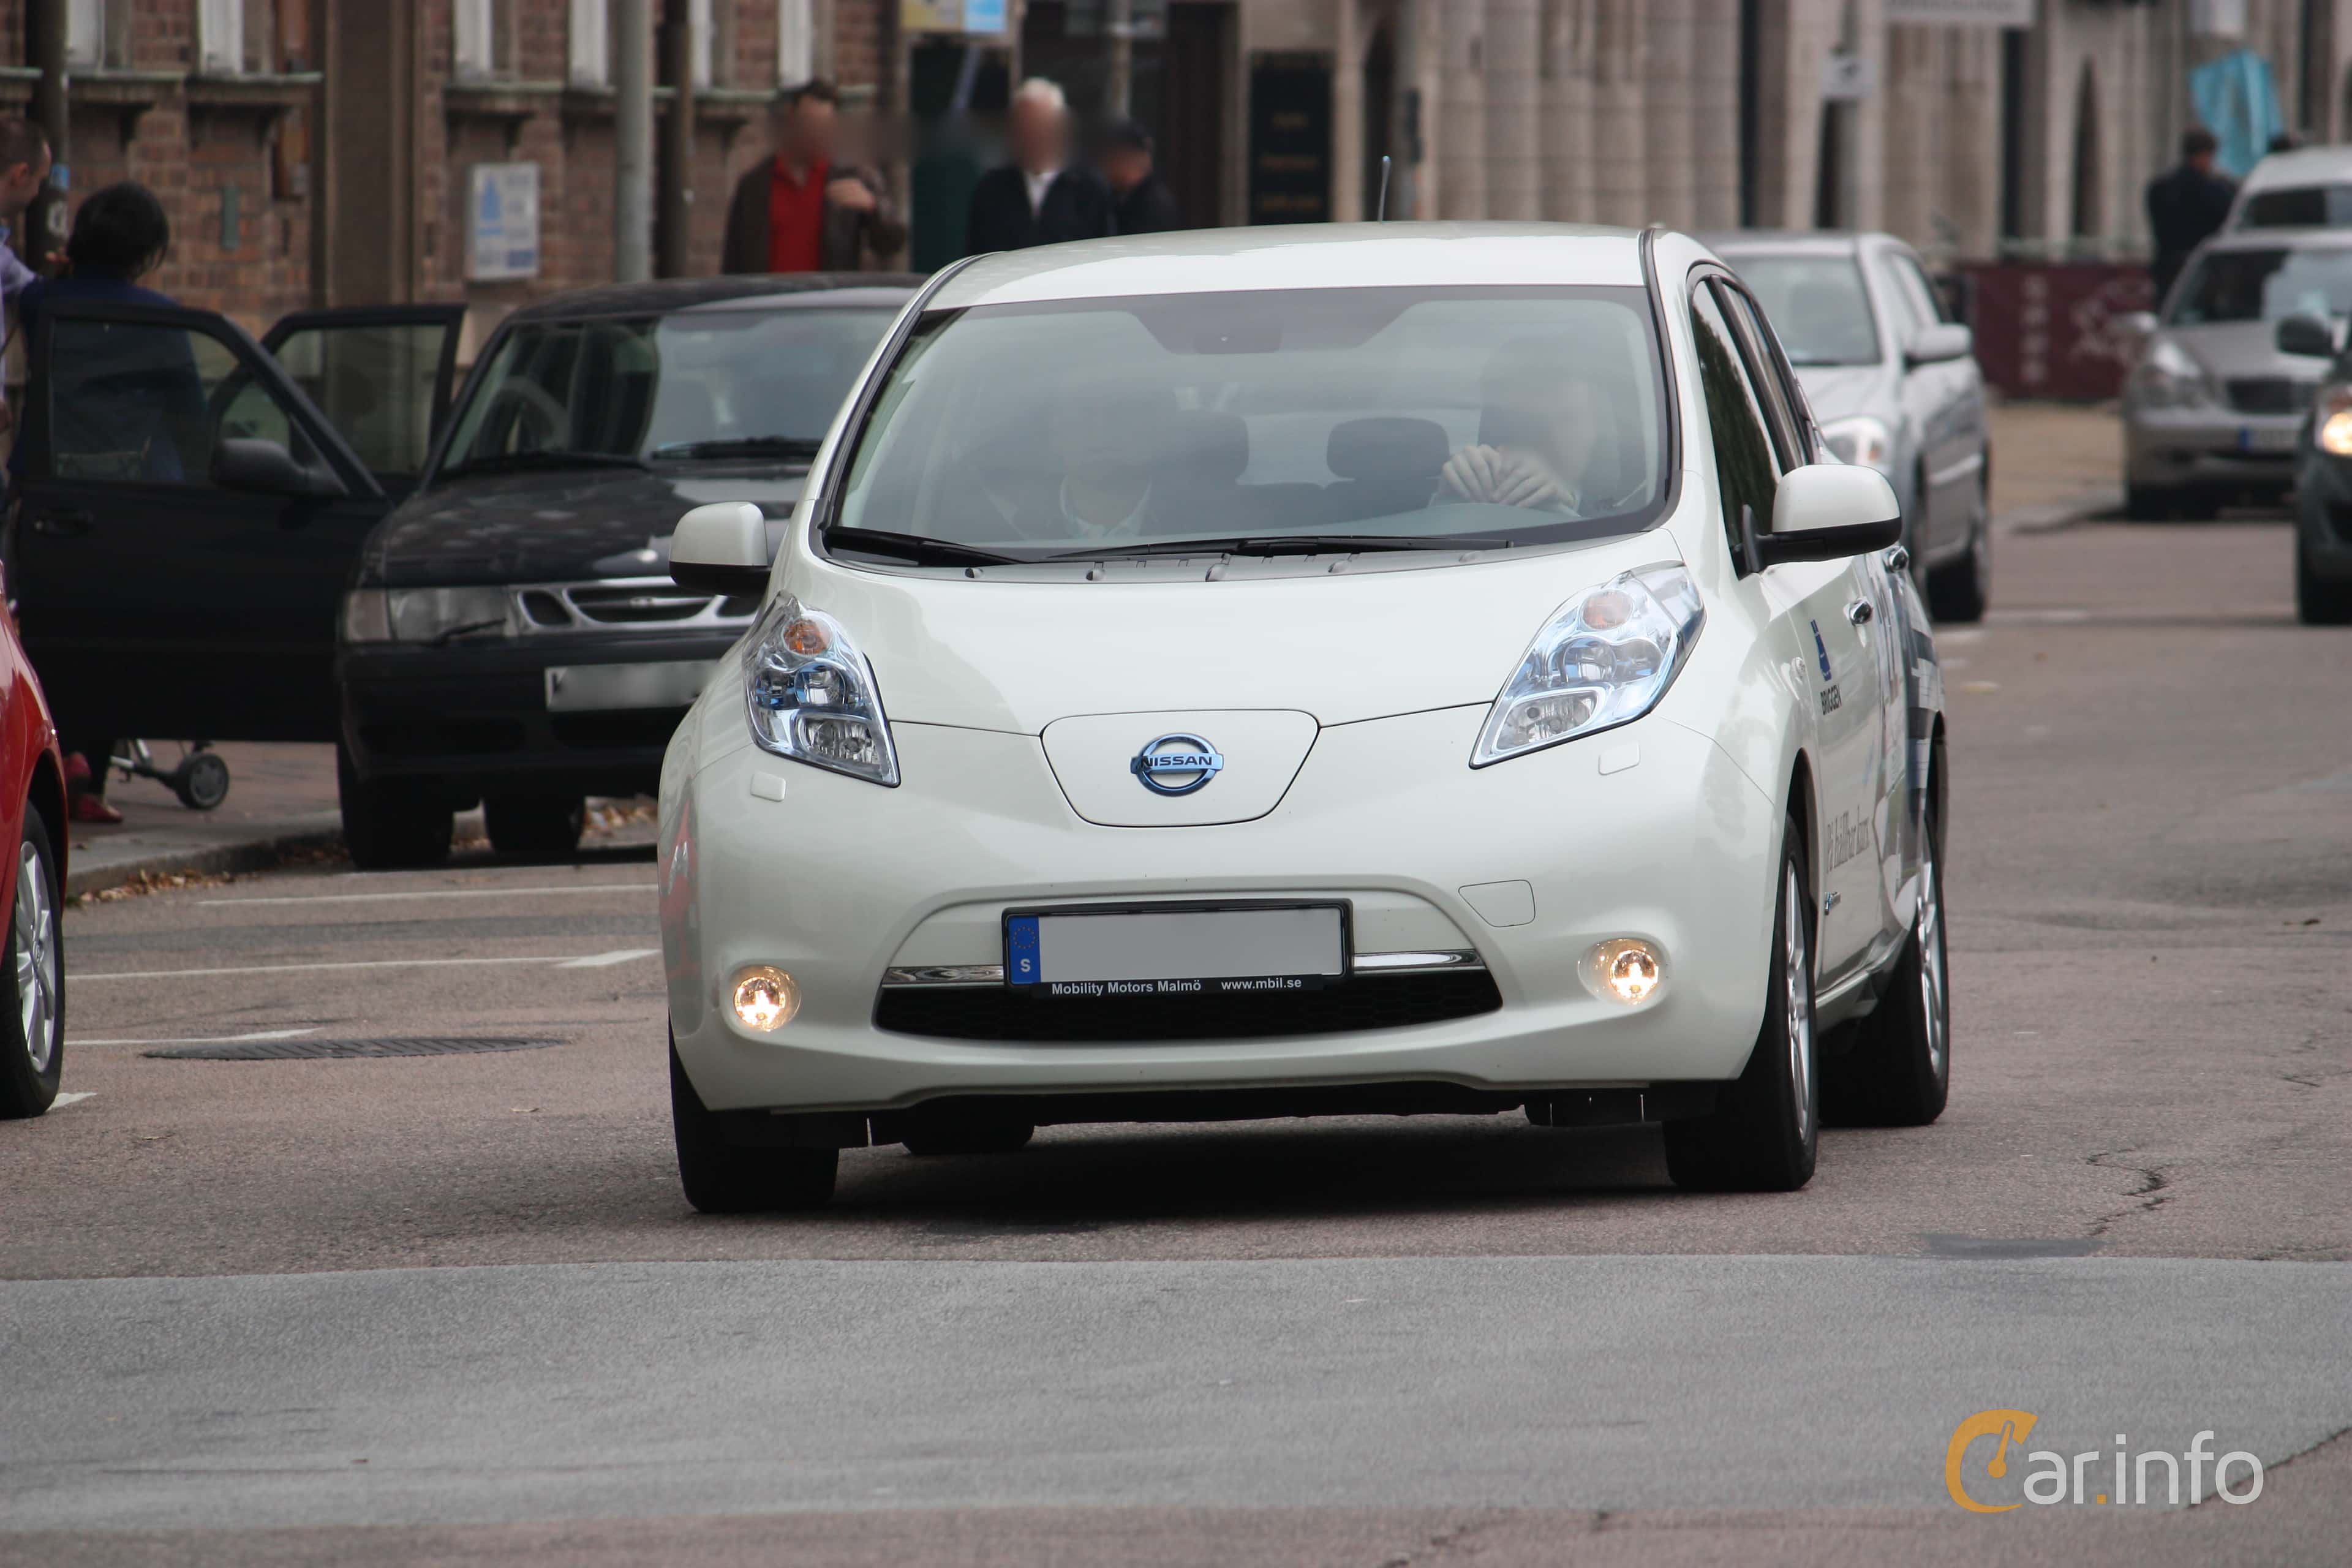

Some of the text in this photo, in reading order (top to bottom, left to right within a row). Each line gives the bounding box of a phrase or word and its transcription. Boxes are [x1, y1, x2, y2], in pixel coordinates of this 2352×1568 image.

[1140, 755, 1212, 767] NISSAN
[1020, 958, 1031, 973] S
[1052, 977, 1302, 997] Mobility Motors Malmö www.mbil.se
